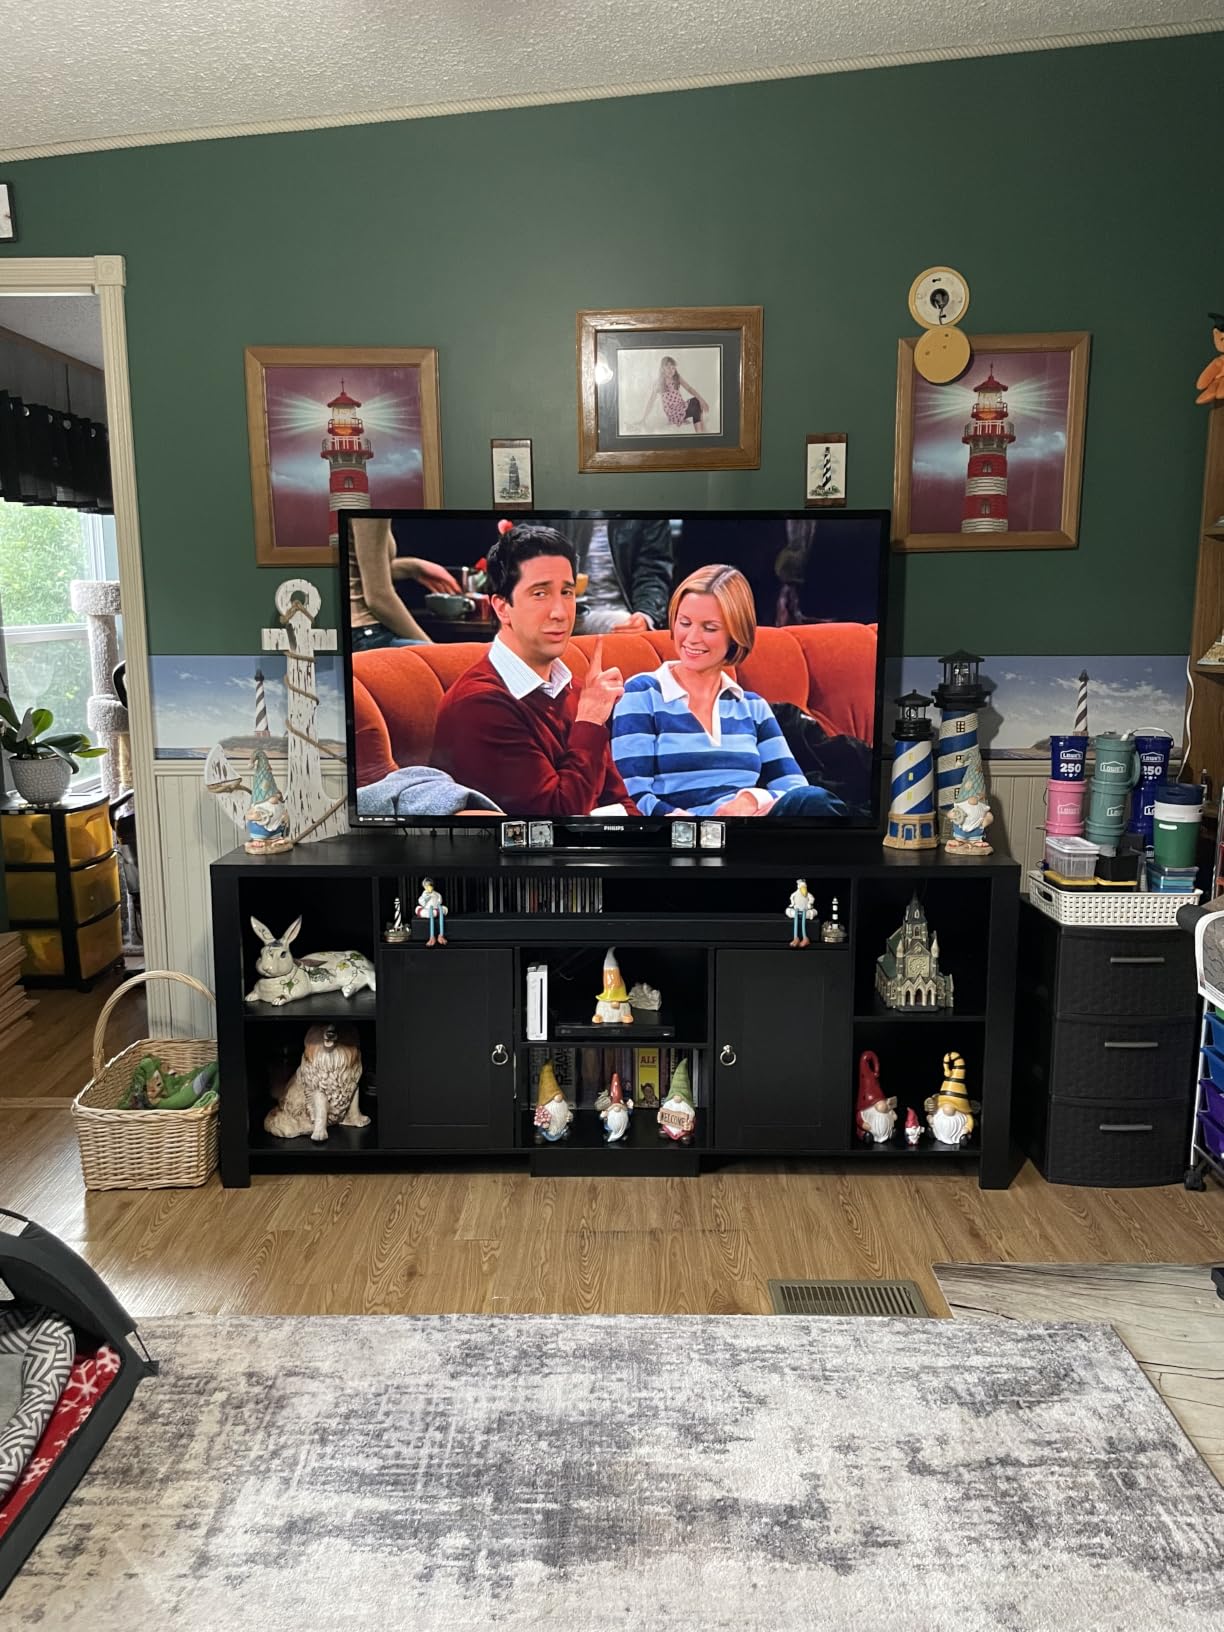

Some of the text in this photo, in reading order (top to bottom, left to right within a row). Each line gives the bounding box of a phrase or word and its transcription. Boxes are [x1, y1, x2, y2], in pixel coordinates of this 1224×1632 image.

[1060, 763, 1081, 773] 250
[640, 1056, 656, 1064] ALF
[660, 1110, 685, 1127] WELCOME
